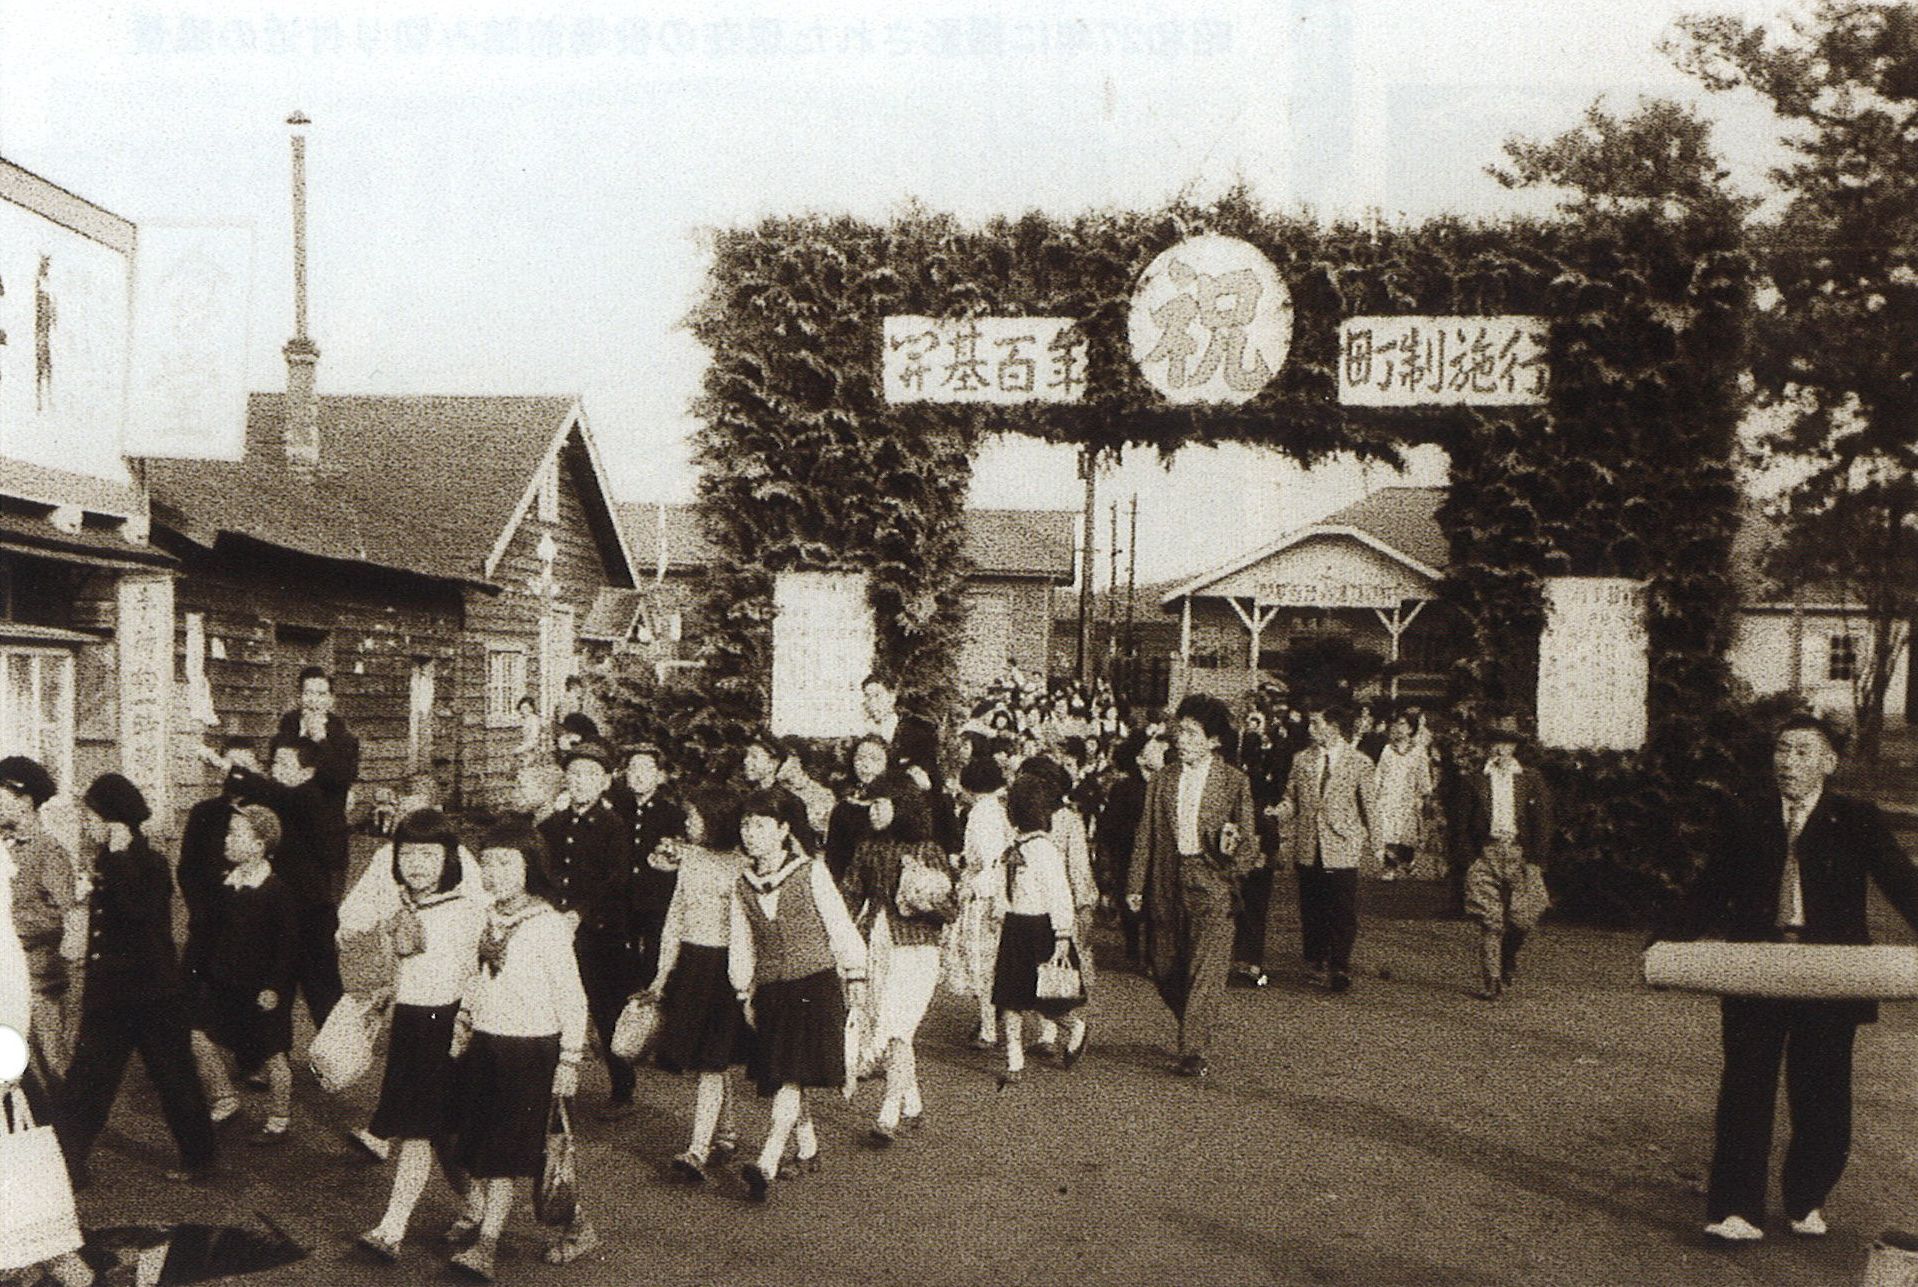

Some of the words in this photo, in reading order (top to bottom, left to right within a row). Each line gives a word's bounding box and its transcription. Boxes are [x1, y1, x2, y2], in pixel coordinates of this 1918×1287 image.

[1144, 257, 1274, 391] 祝
[1346, 327, 1551, 397] 町制施行
